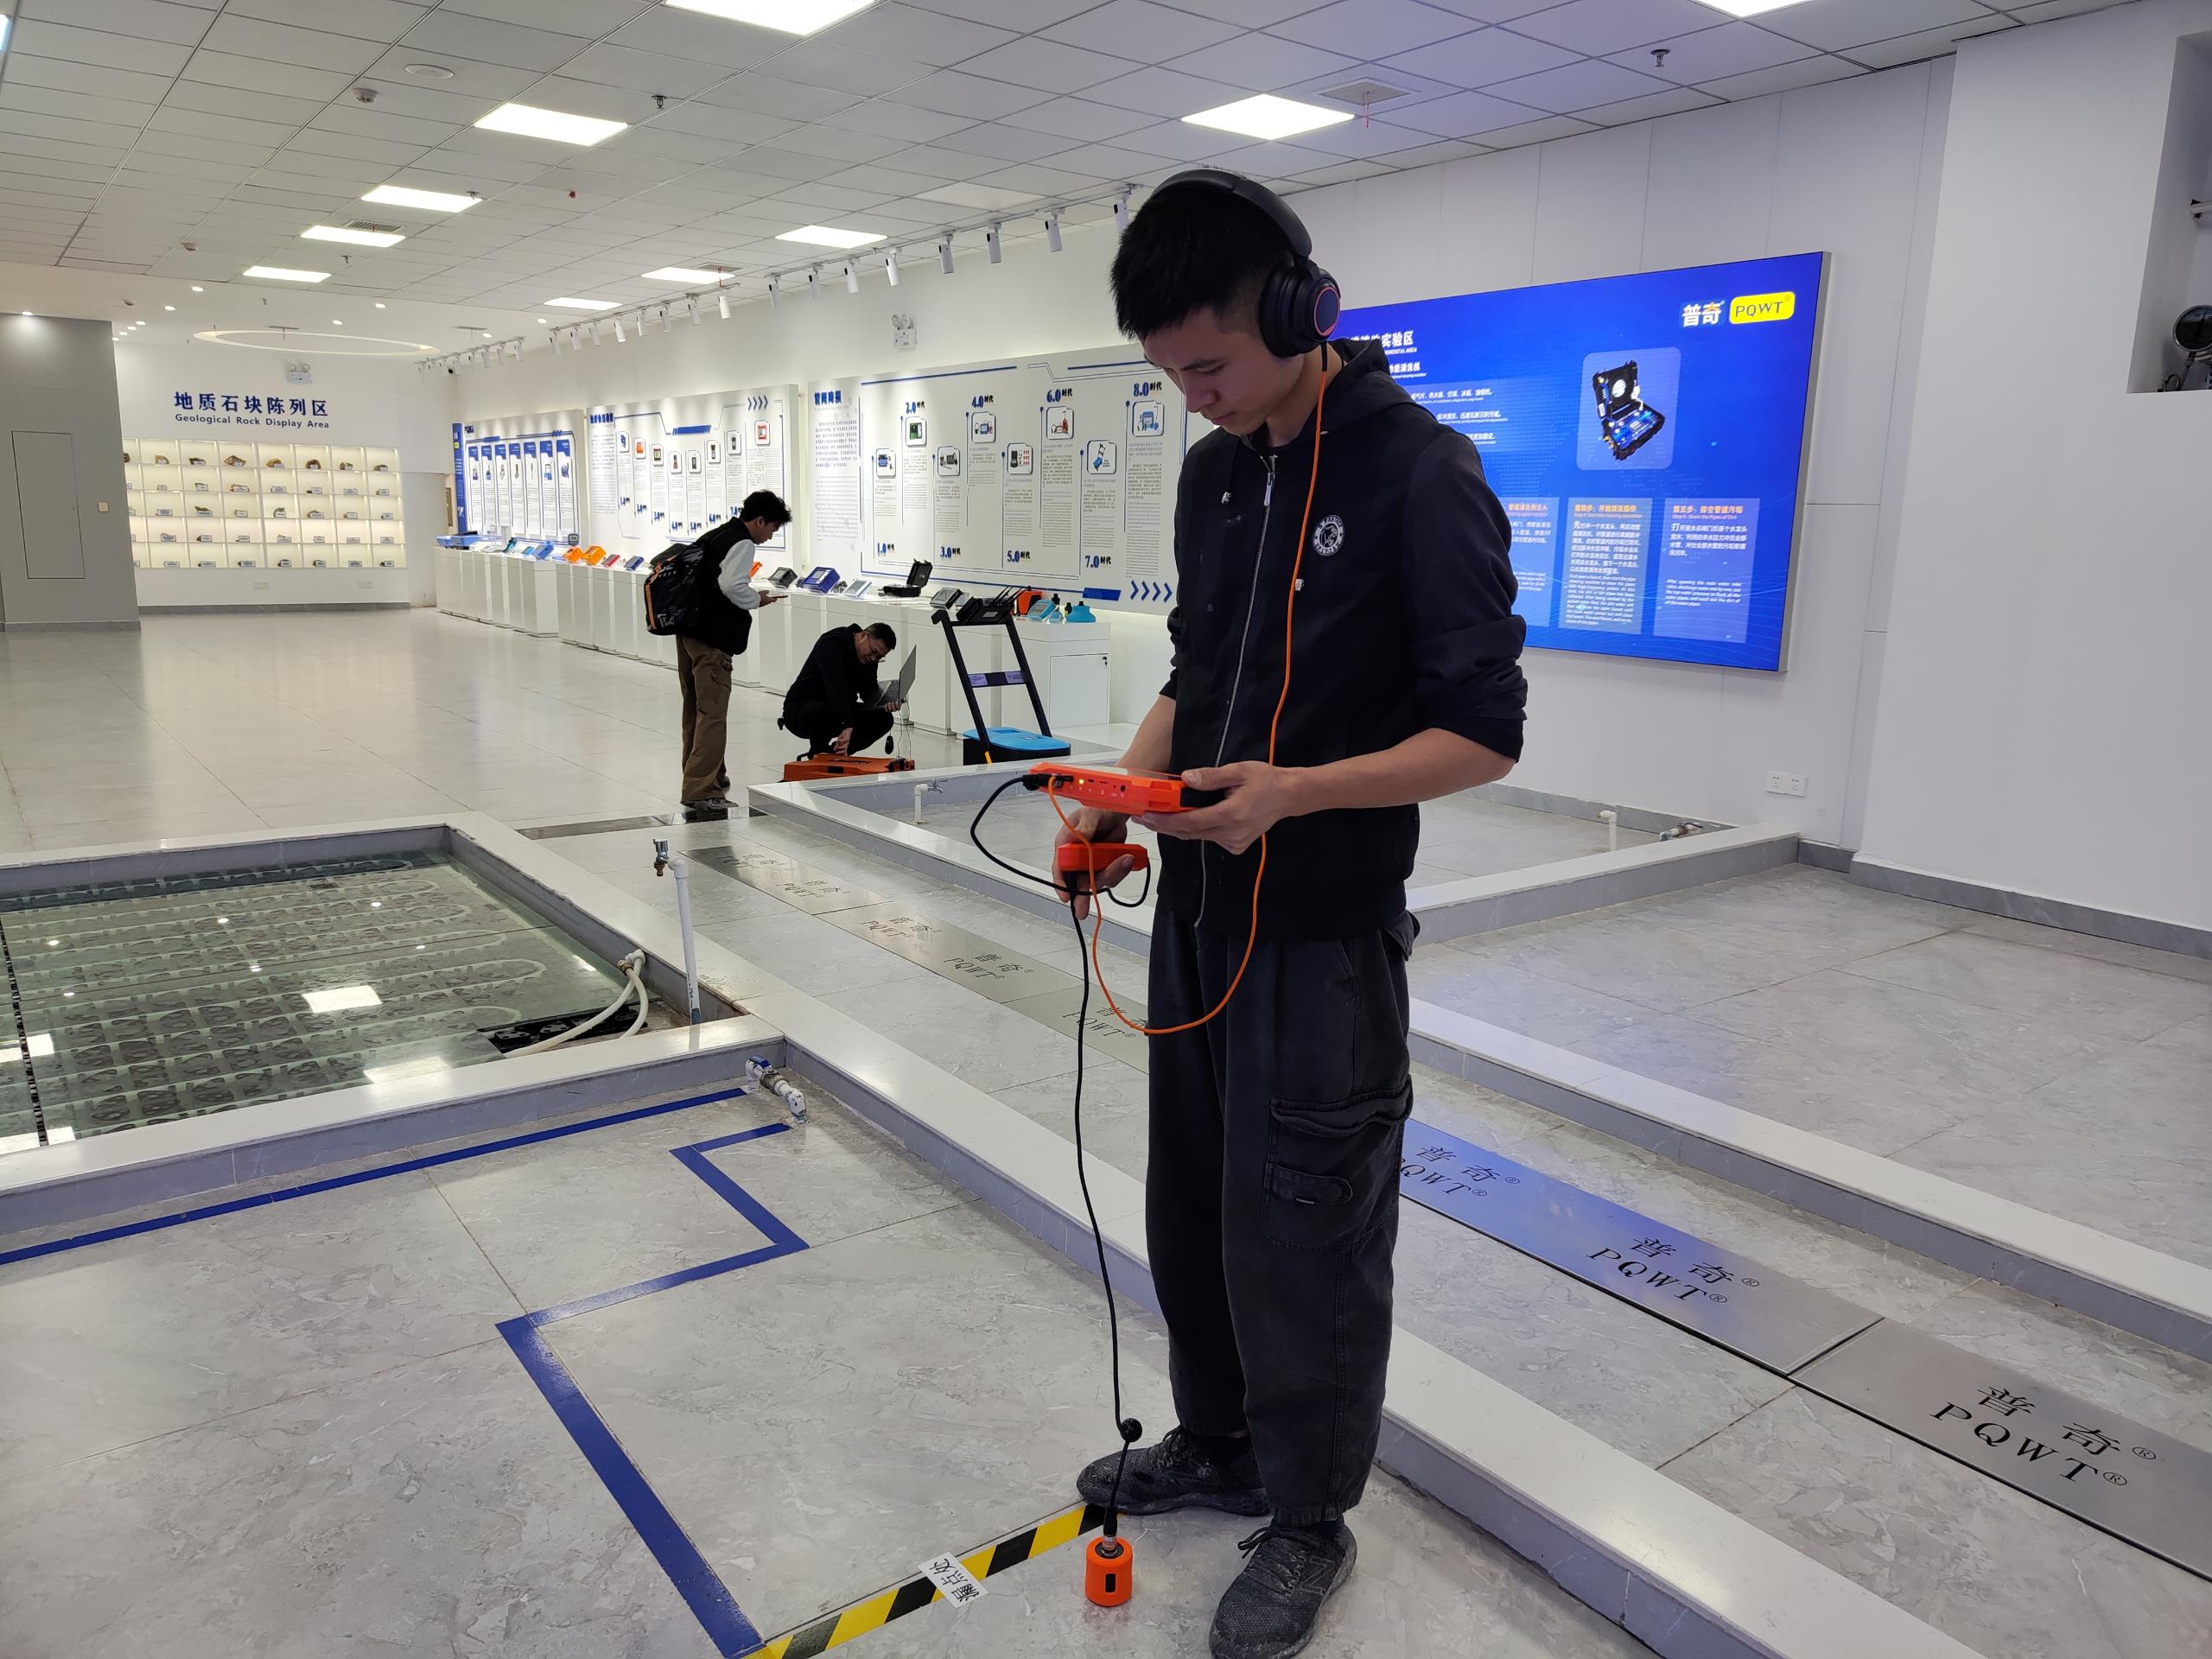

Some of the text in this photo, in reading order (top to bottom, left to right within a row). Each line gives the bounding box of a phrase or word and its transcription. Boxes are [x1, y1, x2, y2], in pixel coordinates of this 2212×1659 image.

[1681, 302, 1722, 327] 普奇
[174, 391, 328, 416] 地质石块陈列区
[175, 414, 329, 429] Geological Rock Display Area
